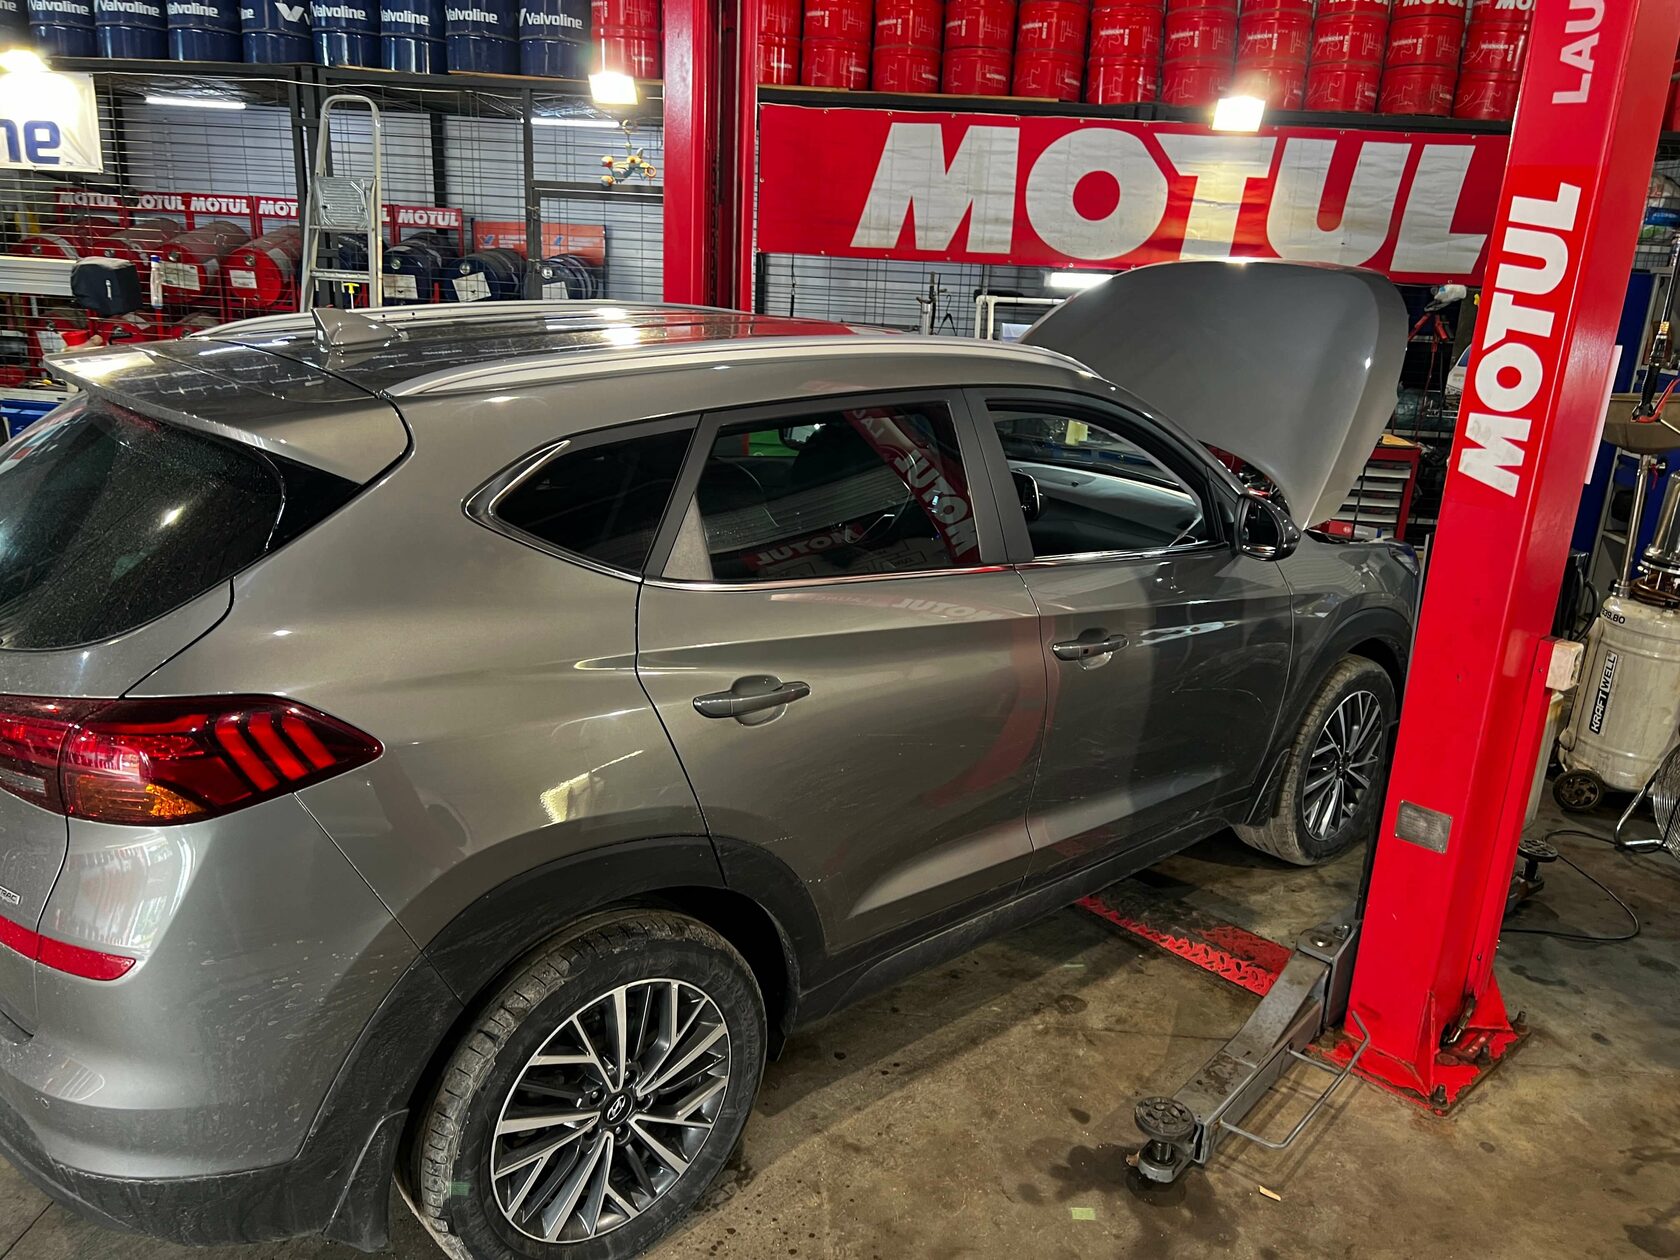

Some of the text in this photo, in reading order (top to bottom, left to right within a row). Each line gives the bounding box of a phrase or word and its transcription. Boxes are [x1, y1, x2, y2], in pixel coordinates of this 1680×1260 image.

[30, 0, 91, 16] Valvoline
[99, 0, 161, 17] Valvoline
[526, 12, 584, 29] Valvoline
[190, 197, 250, 214] MOTUL
[849, 123, 1489, 274] MOTUL
[398, 209, 459, 226] MOTUL
[1457, 182, 1582, 498] MOTUL
